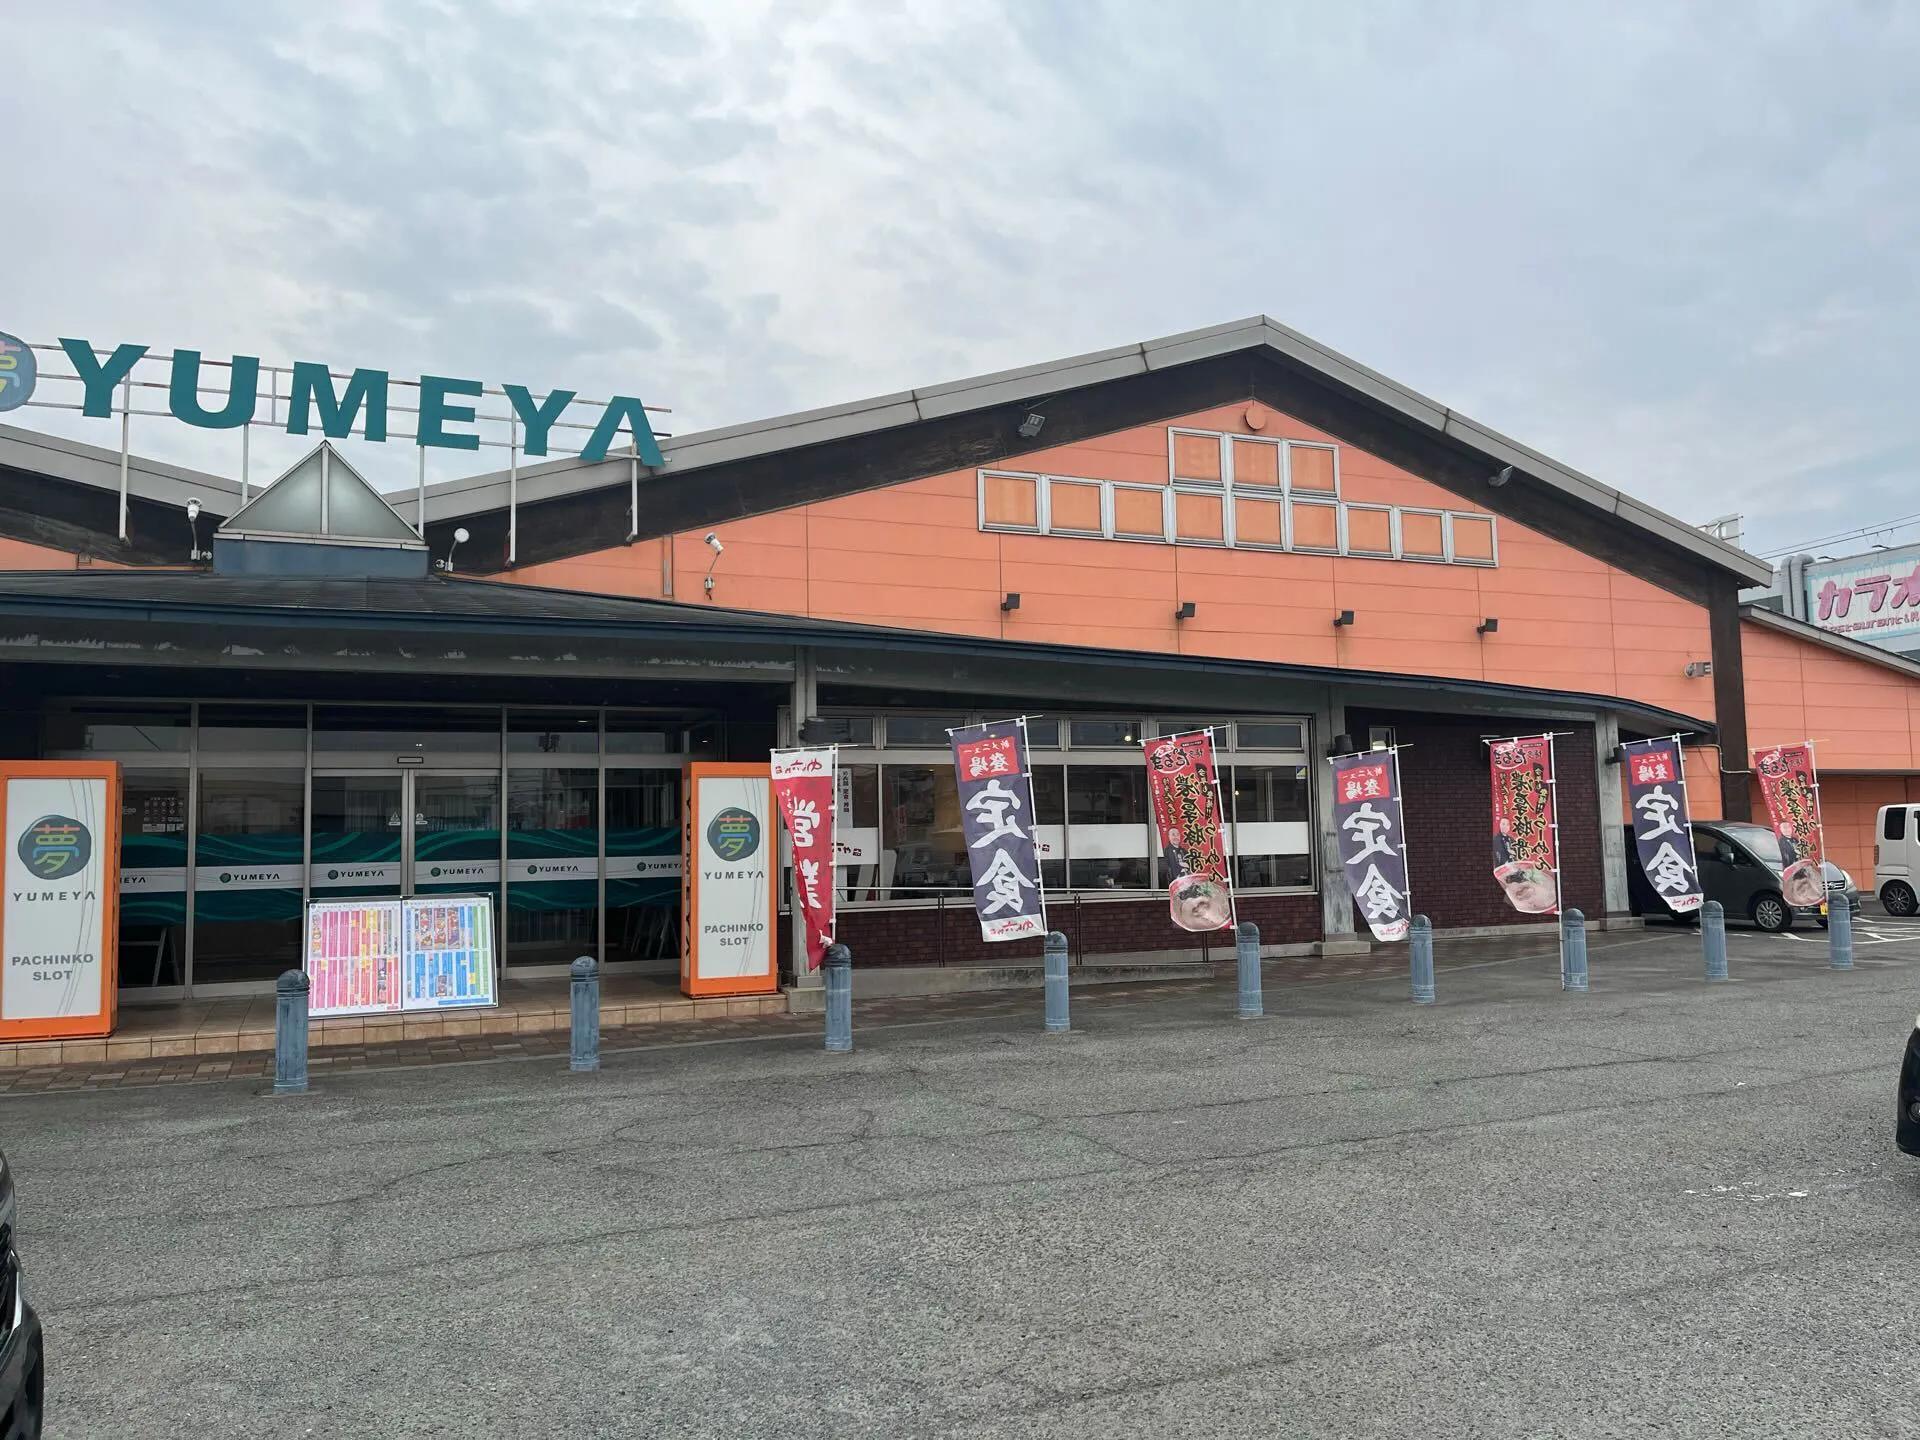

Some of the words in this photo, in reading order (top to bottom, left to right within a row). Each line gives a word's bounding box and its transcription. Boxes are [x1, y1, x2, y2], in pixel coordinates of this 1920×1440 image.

[58, 337, 666, 467] YUMEYA
[717, 814, 753, 856] 夢
[32, 823, 80, 875] 夢
[340, 870, 384, 879] YUMEYA
[442, 867, 484, 875] YUMEYA
[539, 865, 579, 873] YUMEYA
[233, 873, 280, 881] YUMEYA
[704, 870, 765, 880] YUMEYA
[13, 891, 96, 902] YUMEYA
[704, 923, 764, 934] PACHINKO
[720, 937, 749, 947] SLOT
[12, 953, 94, 966] PACHINKO
[33, 970, 73, 981] SLOT
